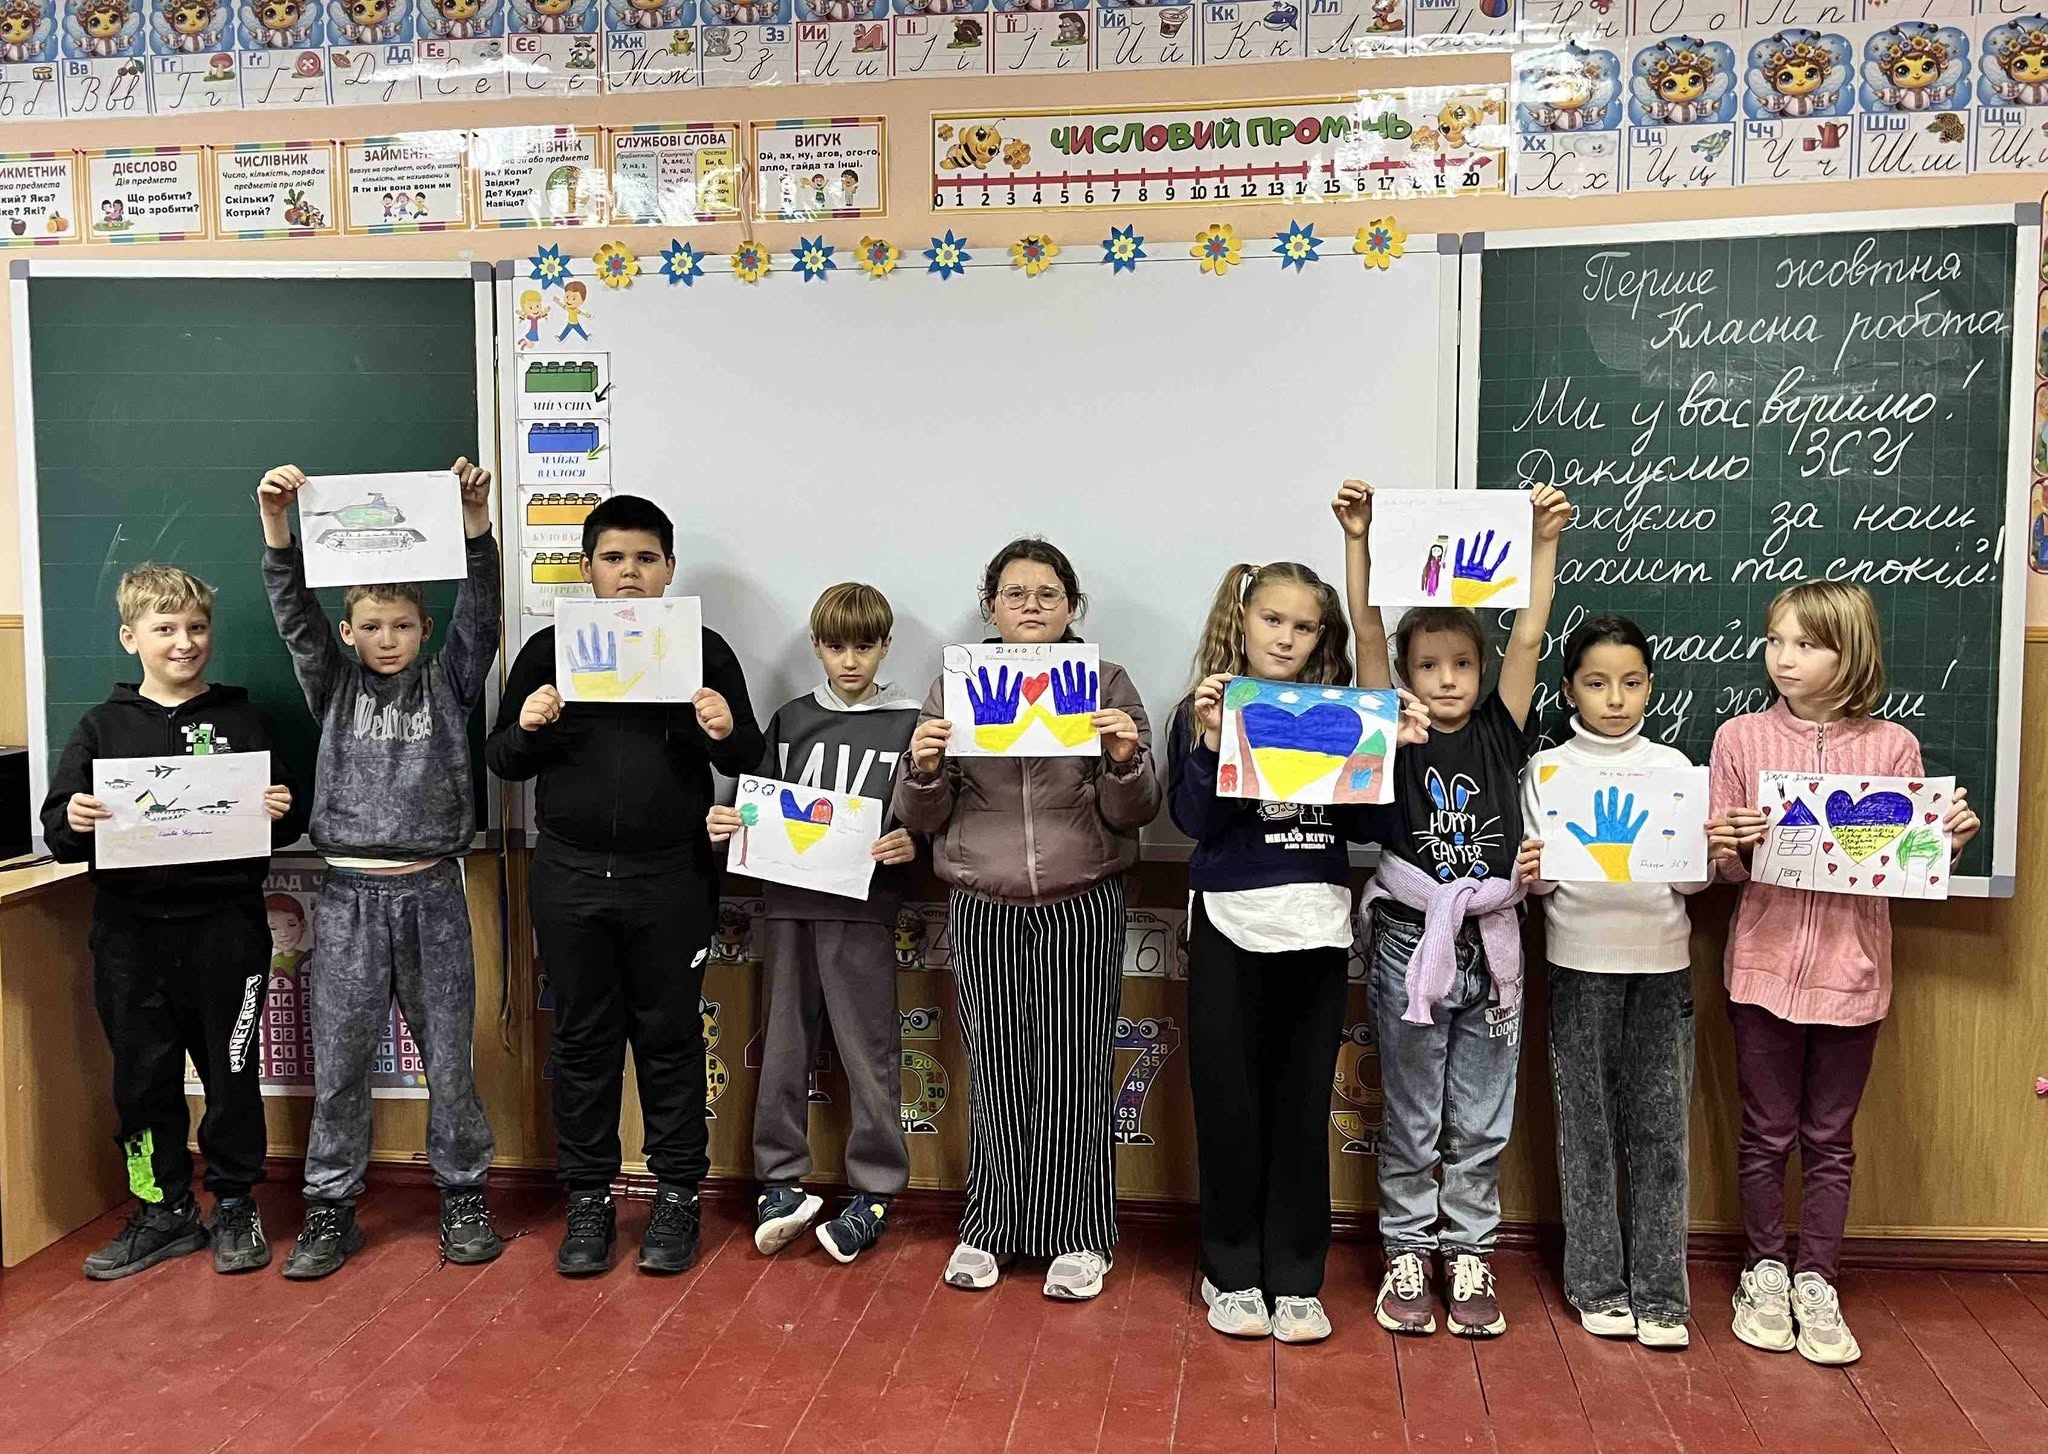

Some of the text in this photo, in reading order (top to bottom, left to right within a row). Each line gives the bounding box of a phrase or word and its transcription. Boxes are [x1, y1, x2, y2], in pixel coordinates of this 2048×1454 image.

[1103, 11, 1127, 27] Йй
[1211, 6, 1235, 22] Кк
[766, 26, 785, 42] Зз
[802, 25, 828, 41] Ии
[515, 37, 537, 52] Єє
[611, 34, 644, 50] Жж
[386, 45, 412, 65] Дд
[426, 42, 445, 58] Ее
[69, 61, 89, 76] Вв
[161, 57, 177, 73] Гг
[1867, 115, 1907, 132] Шш
[1984, 108, 2021, 126] Щщ
[1050, 111, 1413, 155] ЧИСЛОВИЙ ПРОМНЬ
[1636, 128, 1663, 147] Цц
[1748, 124, 1774, 138] Чч
[616, 133, 726, 149] СЛУЖБОВІ СЛОВА
[795, 133, 842, 148] ВИГУК
[1522, 135, 1546, 152] Хх
[234, 153, 309, 168] ЧИСЛІВНИК
[817, 150, 843, 158] агов,
[112, 160, 178, 176] ДІЄСЛОВО
[504, 168, 533, 176] Коли?
[791, 162, 821, 171] гайда
[823, 161, 835, 169] та
[485, 179, 520, 187] Звідки?
[955, 194, 964, 207] 1
[981, 193, 990, 207] 2
[1006, 192, 1016, 206] 3
[1032, 191, 1042, 205] 4
[1060, 190, 1069, 204] 5
[1084, 189, 1094, 204] 6
[1111, 188, 1121, 202] 7
[1138, 187, 1148, 202] 8
[1165, 186, 1175, 200] 9
[1190, 185, 1207, 200] 10
[1214, 185, 1230, 199] 11
[1240, 183, 1257, 197] 12
[1267, 181, 1285, 196] 13
[1324, 179, 1341, 193] 15
[1378, 176, 1395, 191] 17
[1463, 172, 1480, 187] 20
[30, 194, 56, 203] Яка?
[127, 192, 192, 204] Що робити?
[225, 194, 275, 205] Скільки?
[485, 189, 533, 198] Де? Куди?
[128, 204, 199, 216] Що зробити?
[486, 199, 525, 208] Навіщо?
[225, 207, 271, 218] Котрий?
[1582, 237, 1963, 320] Перше жовтня
[1650, 288, 2012, 372] Класна робота
[1512, 375, 1606, 433] Ми
[1631, 400, 1666, 458] у
[1678, 370, 1751, 429] вас
[1516, 427, 1916, 512] Дякуємо ЗСУ
[1560, 504, 1718, 553] якуємо
[1762, 501, 1825, 557] за
[1553, 556, 1713, 586] ахист
[1731, 558, 1810, 585] та
[1430, 811, 1476, 835] HOPPY
[1264, 831, 1335, 844] HELLO KITTY
[1431, 841, 1482, 865] EASTER
[229, 974, 262, 1073] MINECRAFT
[1151, 1043, 1168, 1055] 28
[915, 1058, 932, 1070] 20
[1142, 1056, 1160, 1067] 35
[927, 1087, 945, 1098] 30
[1127, 1081, 1145, 1092] 49
[901, 1109, 918, 1120] 40
[1119, 1107, 1136, 1118] 63
[1116, 1119, 1135, 1131] 70
